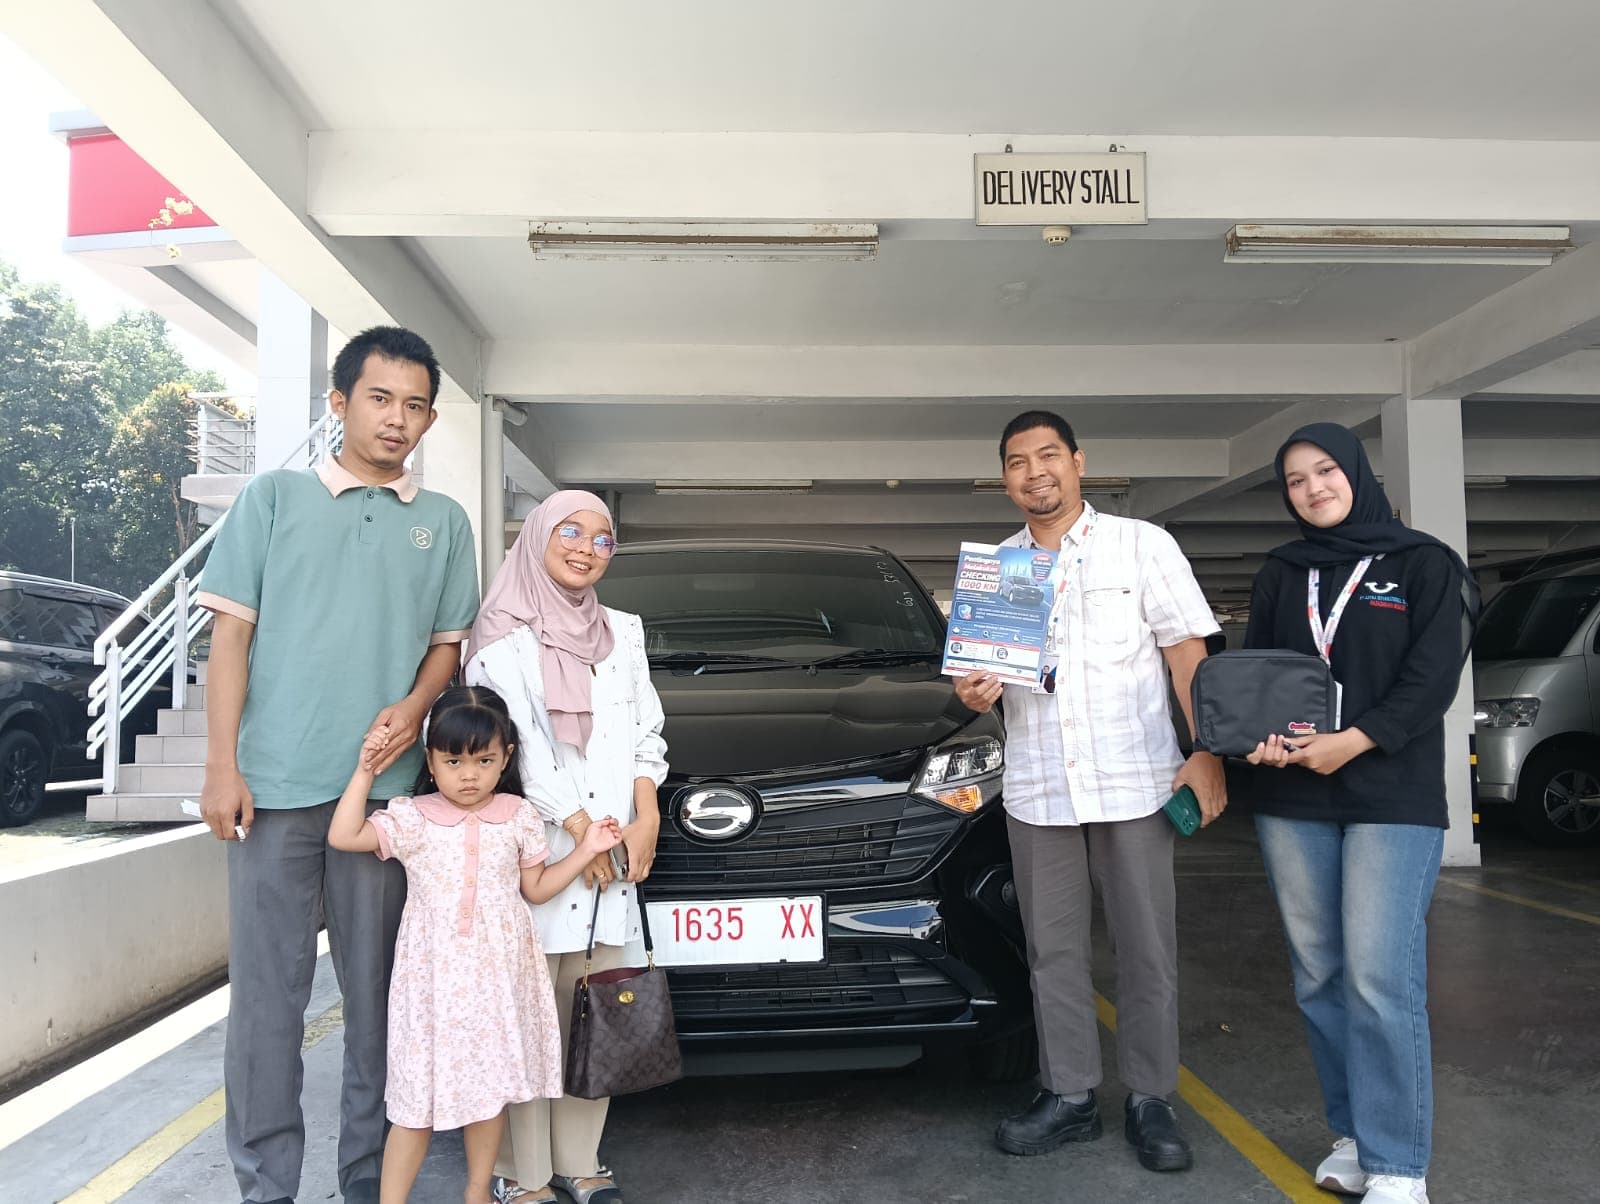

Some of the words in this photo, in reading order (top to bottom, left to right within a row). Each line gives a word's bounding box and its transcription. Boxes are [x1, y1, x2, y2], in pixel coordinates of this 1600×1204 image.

[983, 169, 1076, 205] DELIVERY
[1080, 168, 1140, 204] STALL
[960, 571, 1001, 582] CHECKING
[960, 580, 981, 590] 1000
[983, 583, 997, 591] KM
[672, 906, 743, 942] 1635
[781, 903, 815, 939] XX
